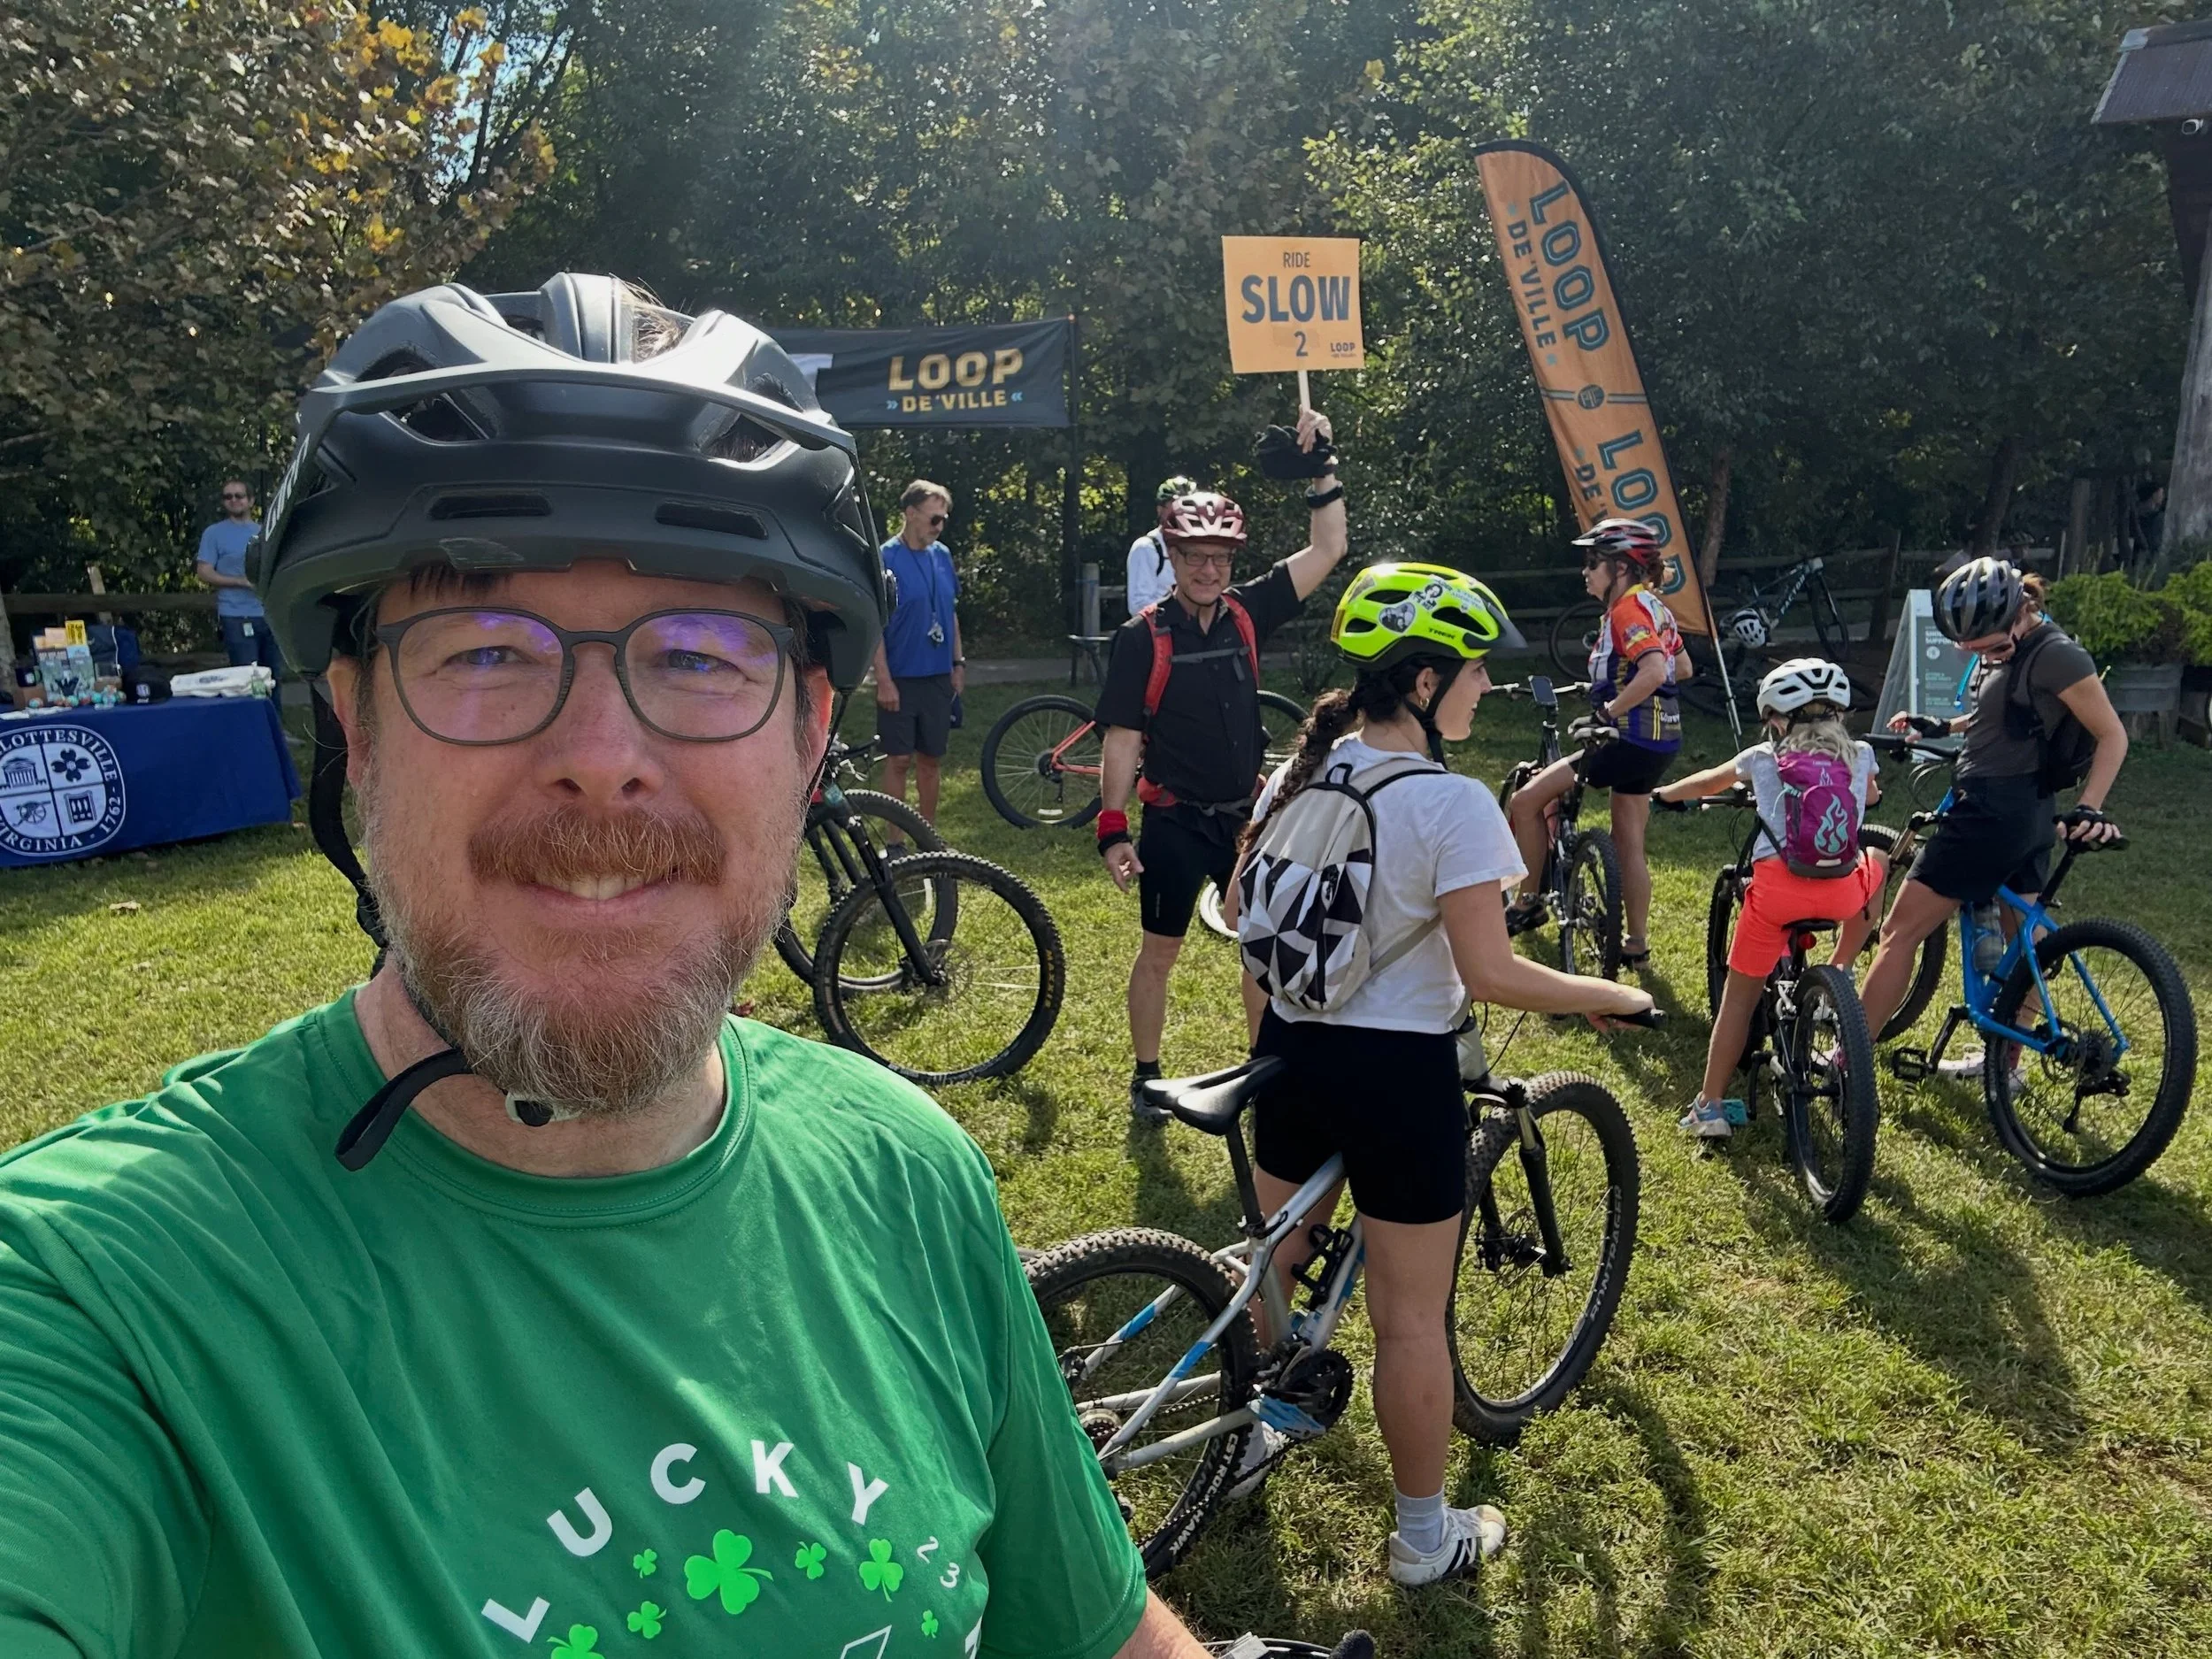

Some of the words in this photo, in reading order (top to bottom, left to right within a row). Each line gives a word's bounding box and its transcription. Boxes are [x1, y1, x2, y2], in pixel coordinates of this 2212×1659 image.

[1283, 252, 1310, 268] RIDE
[1529, 180, 1609, 352] LOOP
[1241, 274, 1350, 324] SLOW
[1294, 331, 1309, 357] 2
[1330, 342, 1356, 352] LOOP
[888, 348, 1024, 392] LOOP
[1428, 626, 1455, 640] TREK
[0, 729, 118, 782] LOTTESVILLE
[99, 796, 121, 834] 1762
[1589, 1184, 1623, 1322] BONTRAGER
[1222, 1432, 1239, 1465] CST
[481, 1440, 888, 1644] LUCKY
[1169, 1509, 1204, 1555] HAWK
